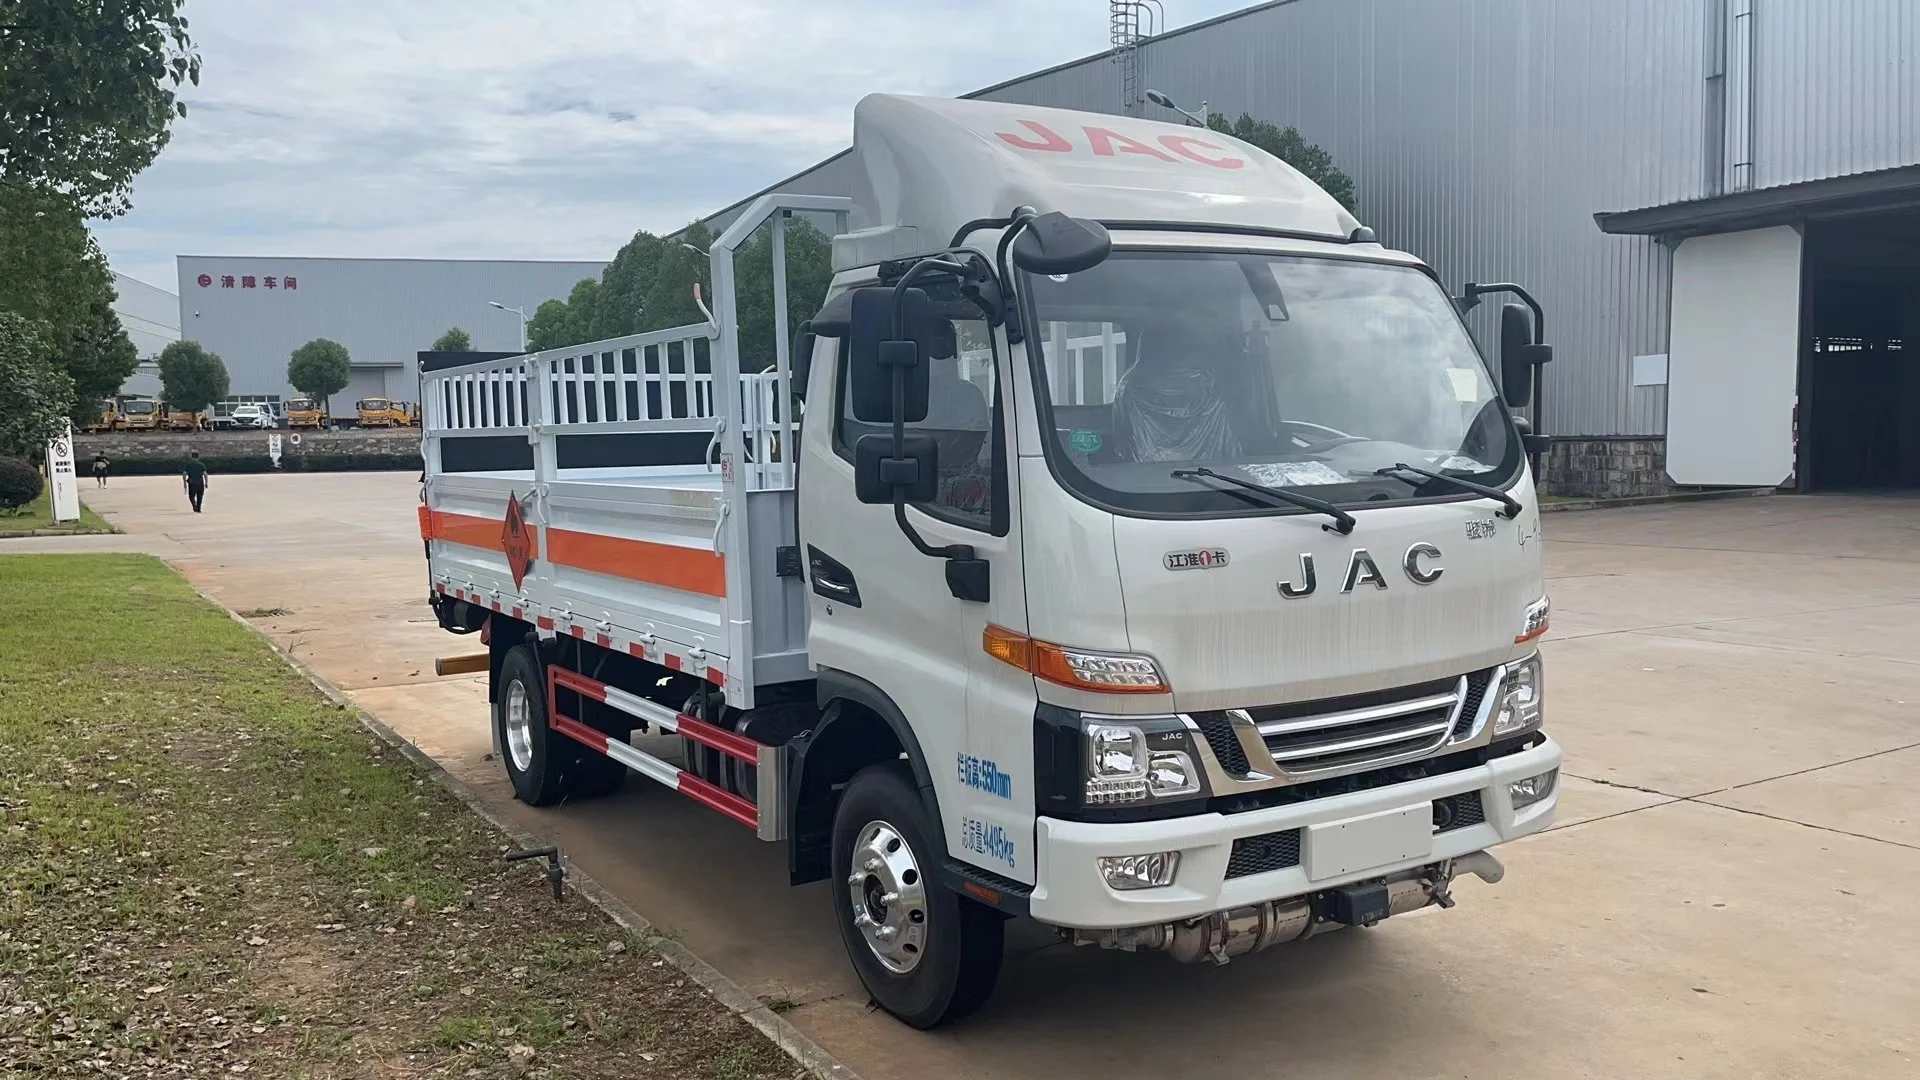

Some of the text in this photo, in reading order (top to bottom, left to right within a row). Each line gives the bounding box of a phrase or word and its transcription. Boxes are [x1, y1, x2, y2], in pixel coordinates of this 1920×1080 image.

[993, 119, 1244, 169] JAC
[1277, 541, 1444, 600] JAC
[1162, 732, 1183, 741] JAC
